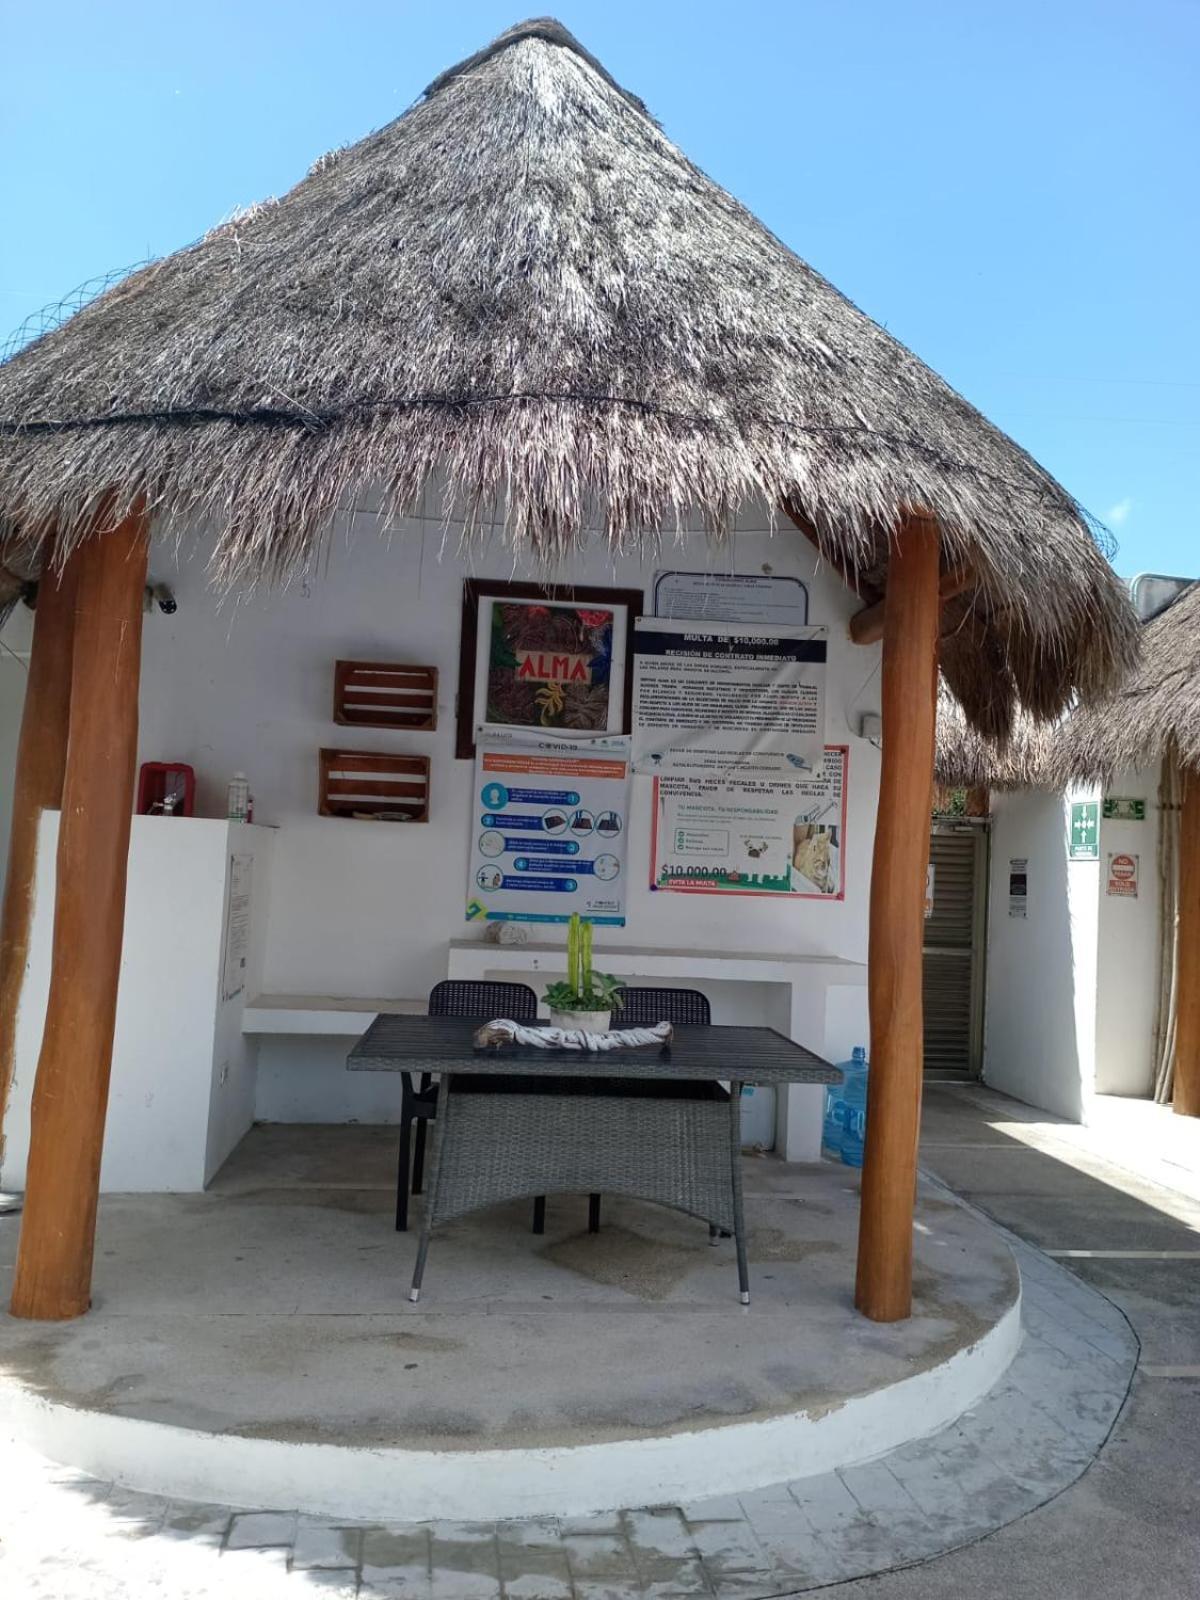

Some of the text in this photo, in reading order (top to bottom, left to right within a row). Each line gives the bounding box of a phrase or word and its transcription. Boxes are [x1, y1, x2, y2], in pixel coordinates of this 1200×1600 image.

[684, 633, 713, 643] MULTA
[703, 650, 713, 658] DE
[715, 652, 754, 660] CONTRATO
[756, 654, 797, 662] INMEDIATO
[519, 654, 587, 680] ALMA
